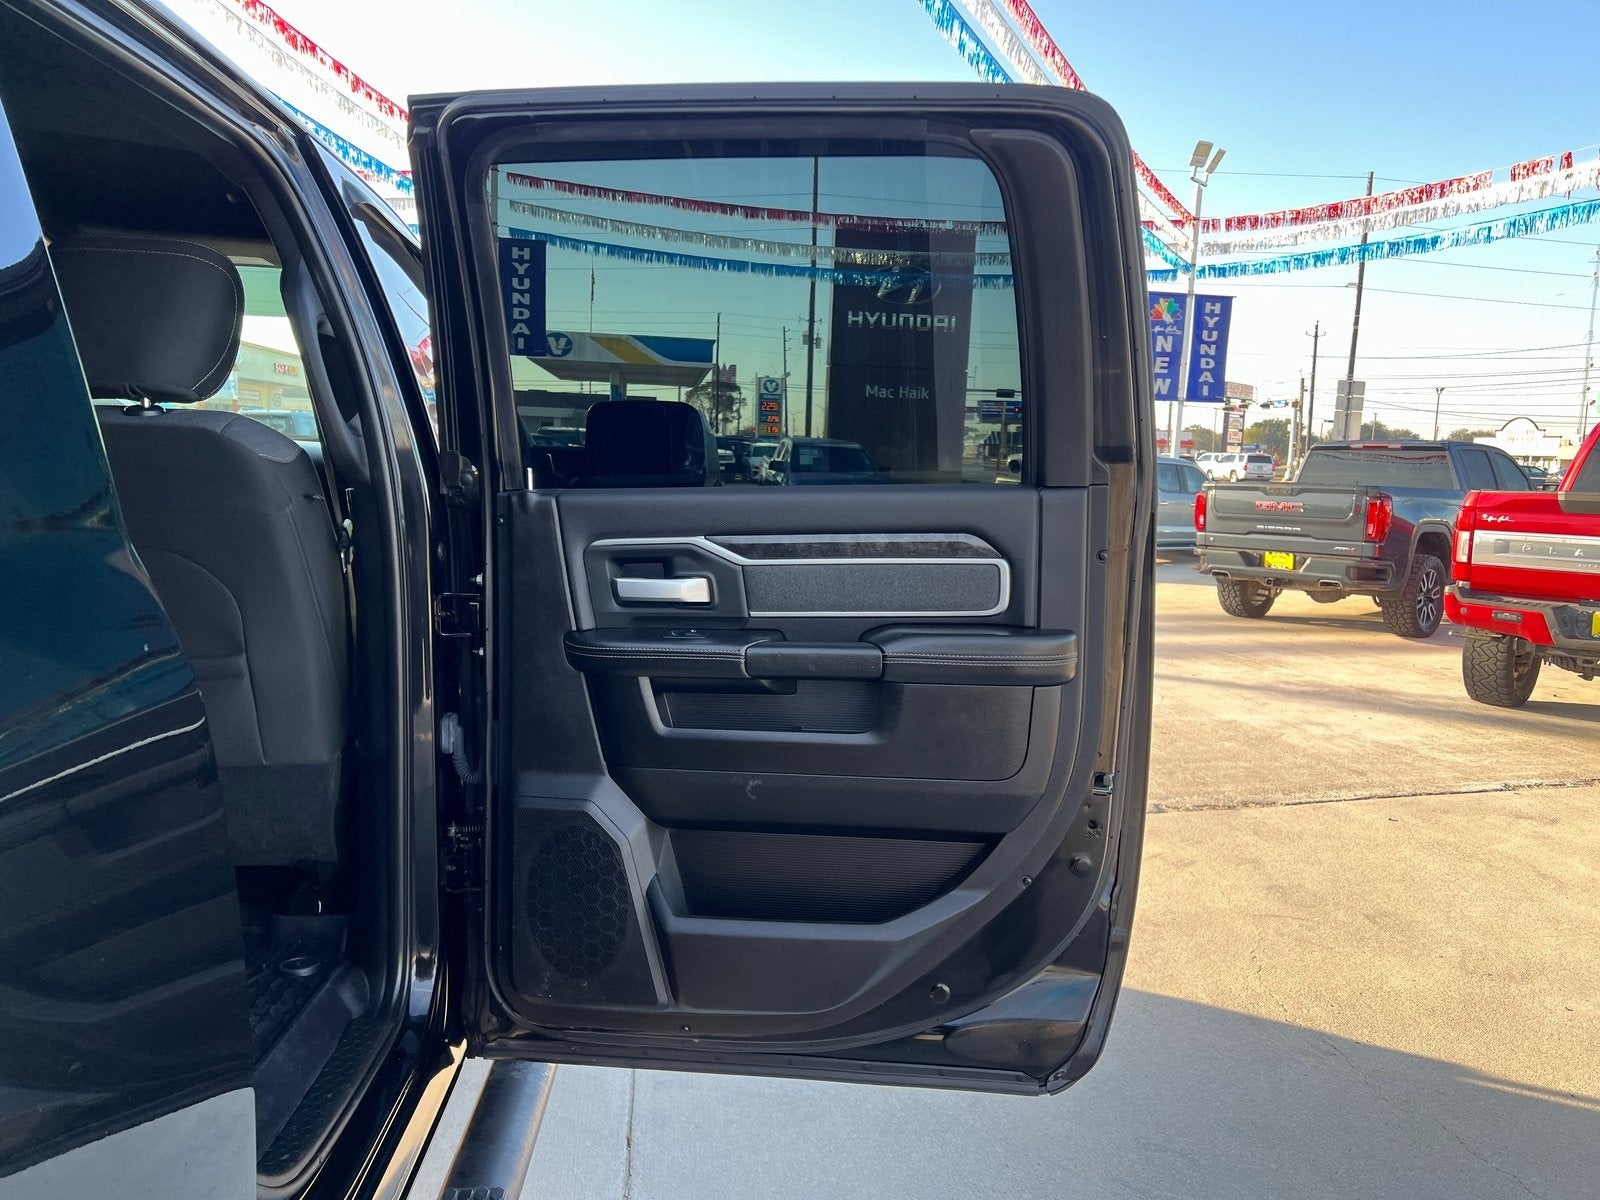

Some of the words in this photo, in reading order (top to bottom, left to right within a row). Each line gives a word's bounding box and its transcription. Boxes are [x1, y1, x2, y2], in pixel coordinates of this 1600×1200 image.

[511, 247, 531, 350] HYUNDAI
[847, 310, 957, 333] HYUNDAI
[1153, 335, 1173, 395] NEW
[1198, 302, 1222, 397] HYUNDAI
[865, 384, 894, 398] Mac
[899, 385, 930, 400] Haik
[1255, 500, 1304, 513] GMC
